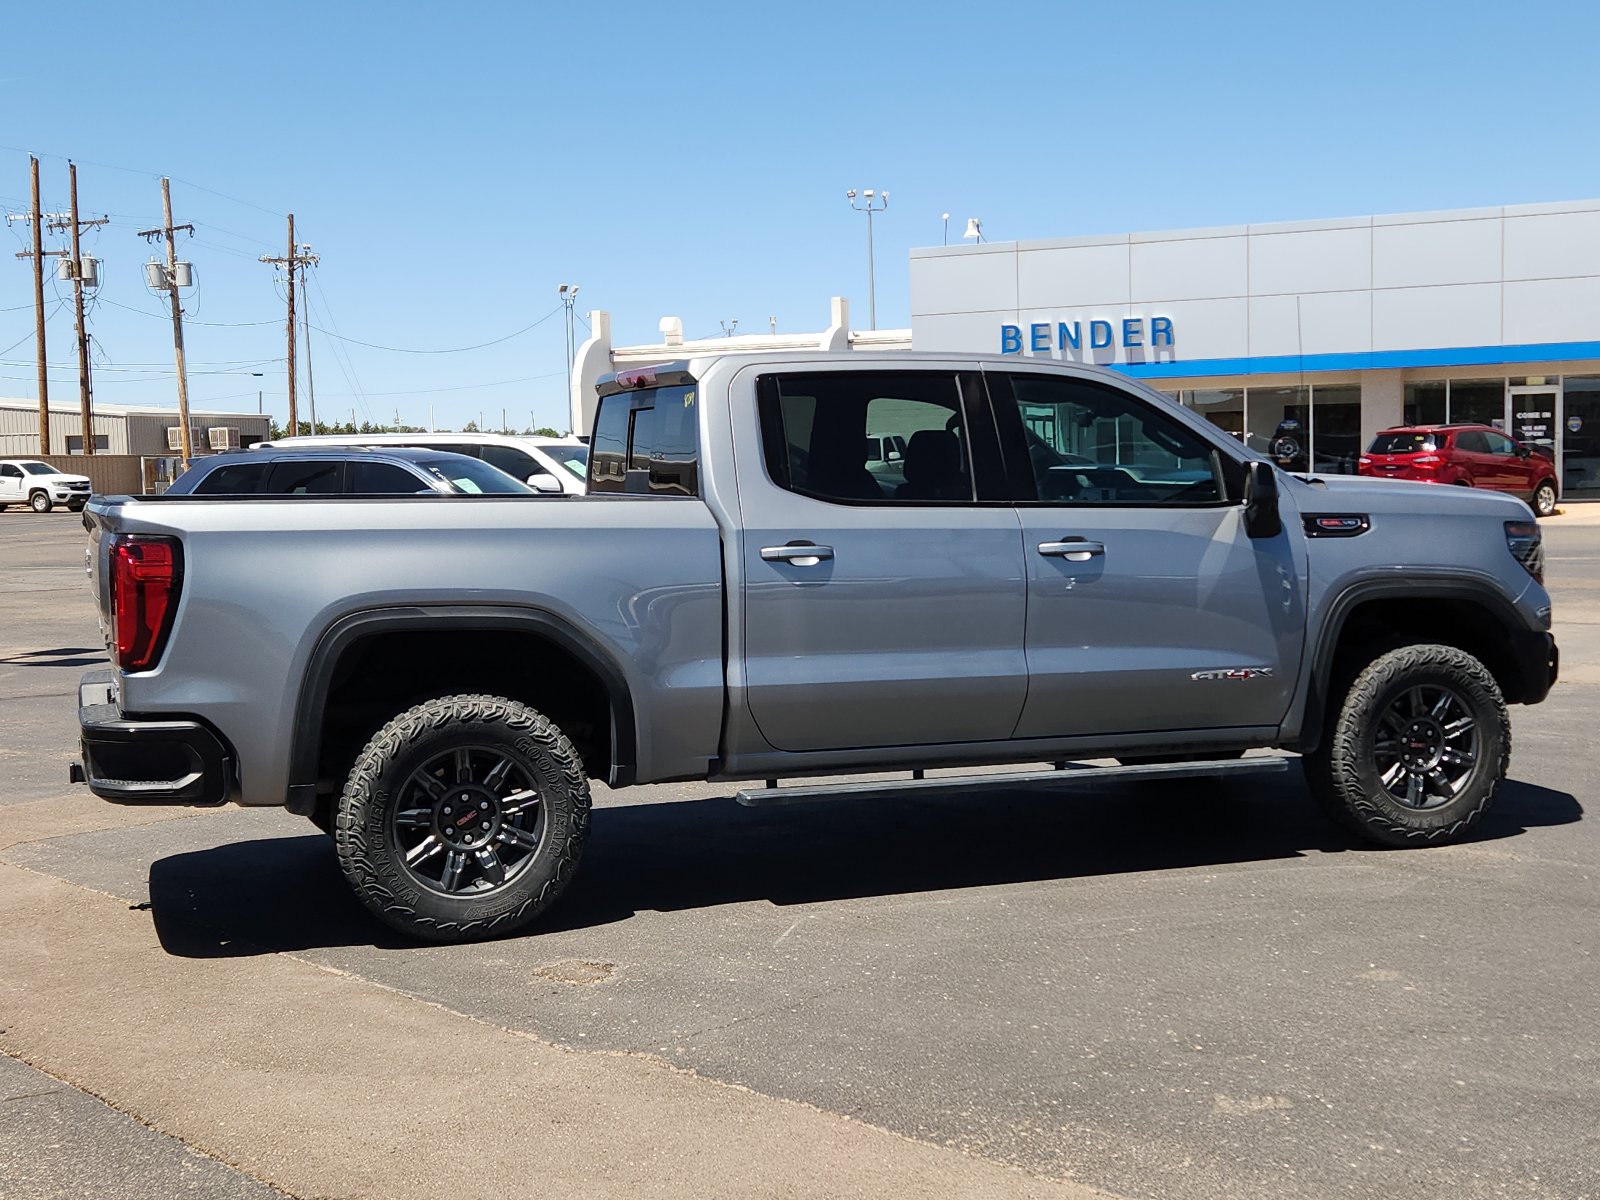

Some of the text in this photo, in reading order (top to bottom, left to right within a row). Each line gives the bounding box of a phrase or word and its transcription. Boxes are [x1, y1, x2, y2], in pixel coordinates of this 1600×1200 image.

[1001, 317, 1173, 354] BENDER
[1190, 667, 1273, 681] AT4X
[456, 809, 478, 827] GMC
[369, 790, 421, 907] WRANGLER
